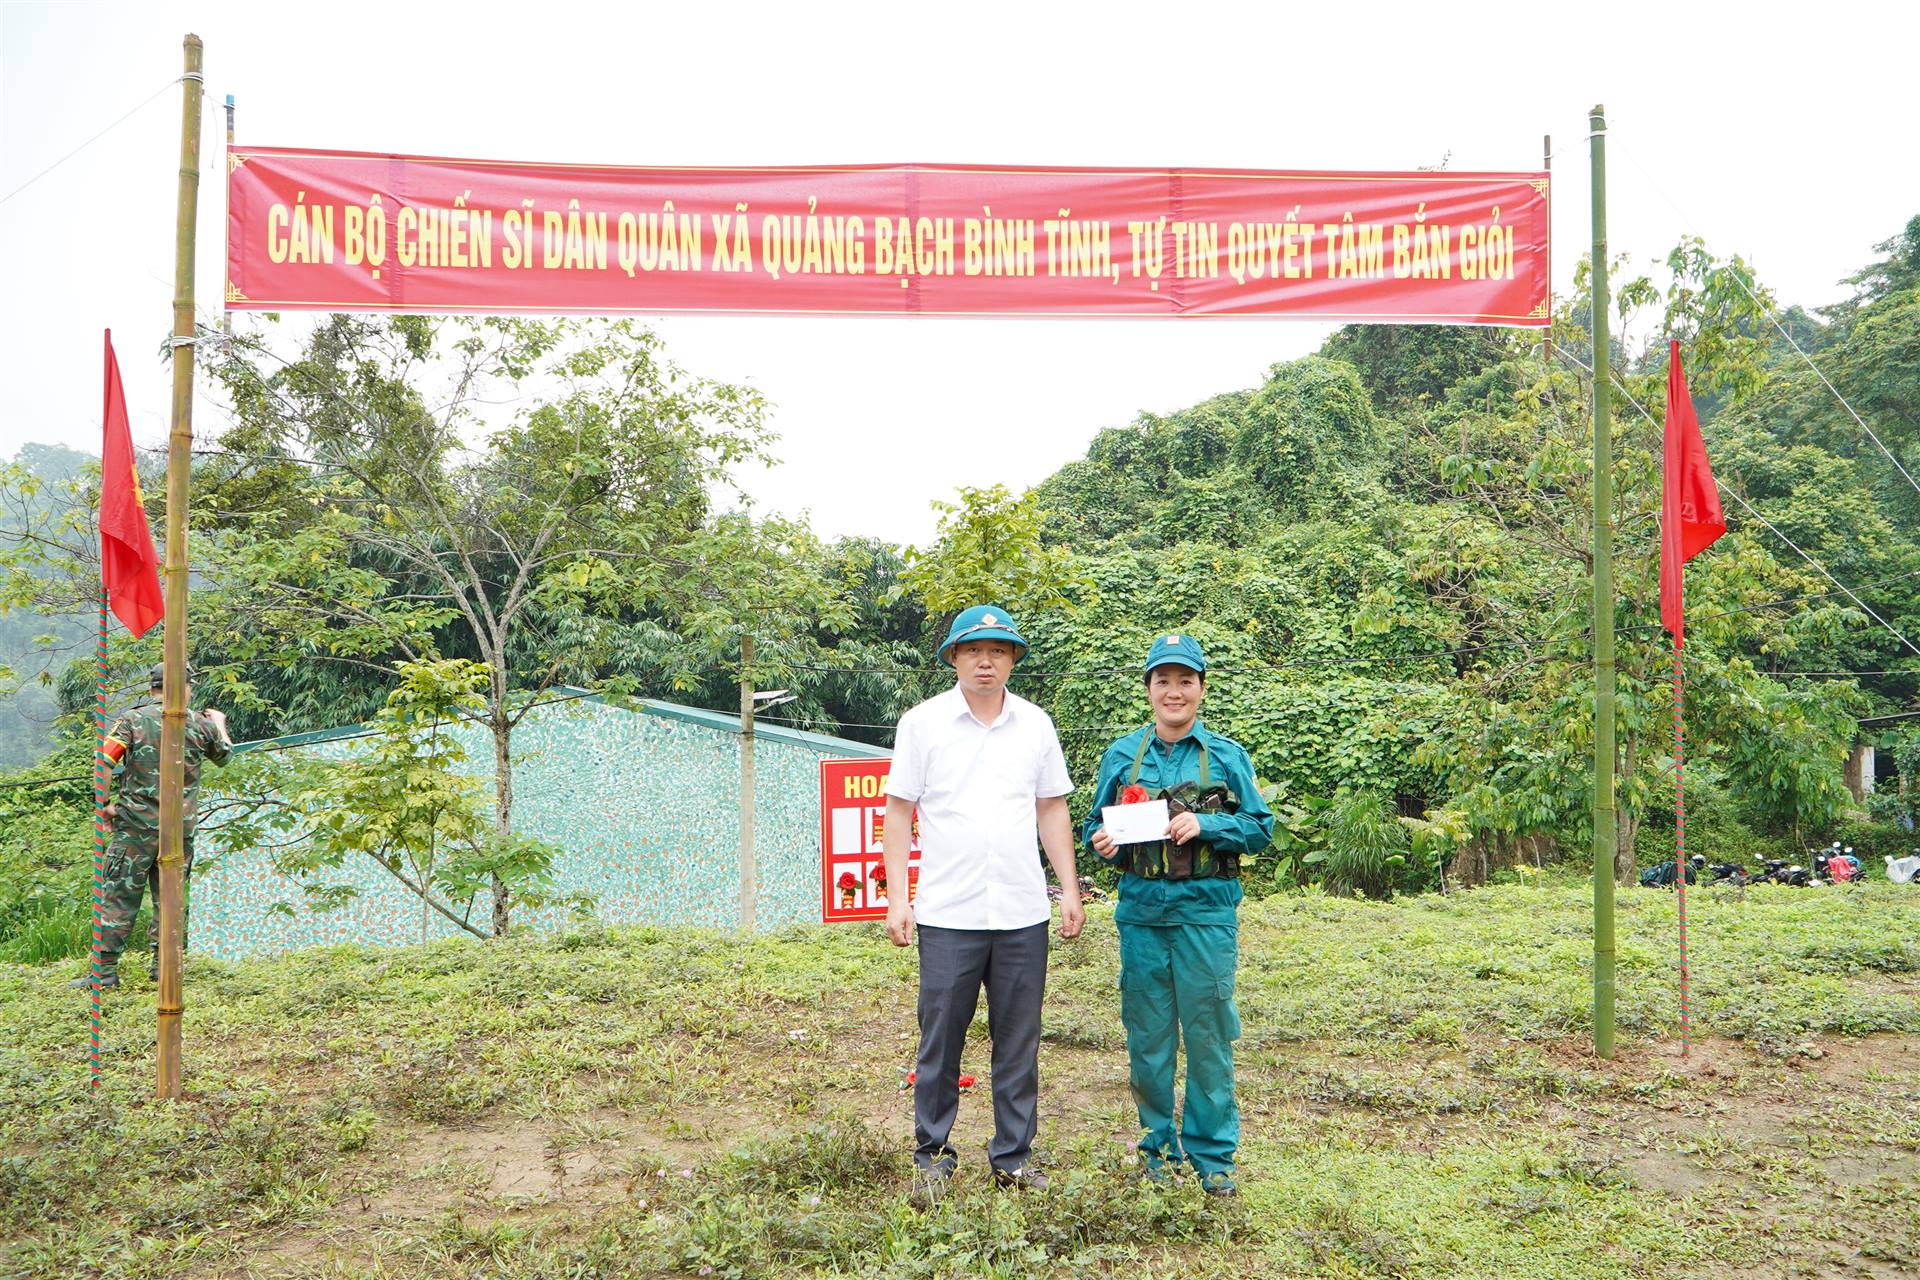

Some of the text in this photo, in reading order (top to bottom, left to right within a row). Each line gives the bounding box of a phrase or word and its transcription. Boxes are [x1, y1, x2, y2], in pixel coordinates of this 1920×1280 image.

[269, 190, 1514, 290] CÁN BỘ CHIẾN SĨ DÂN QUÂN XÃ QUẢNG BẠCH BÌNH TĨNH, TỰ TIN QUYẾT TÂM BẮN GIỎI
